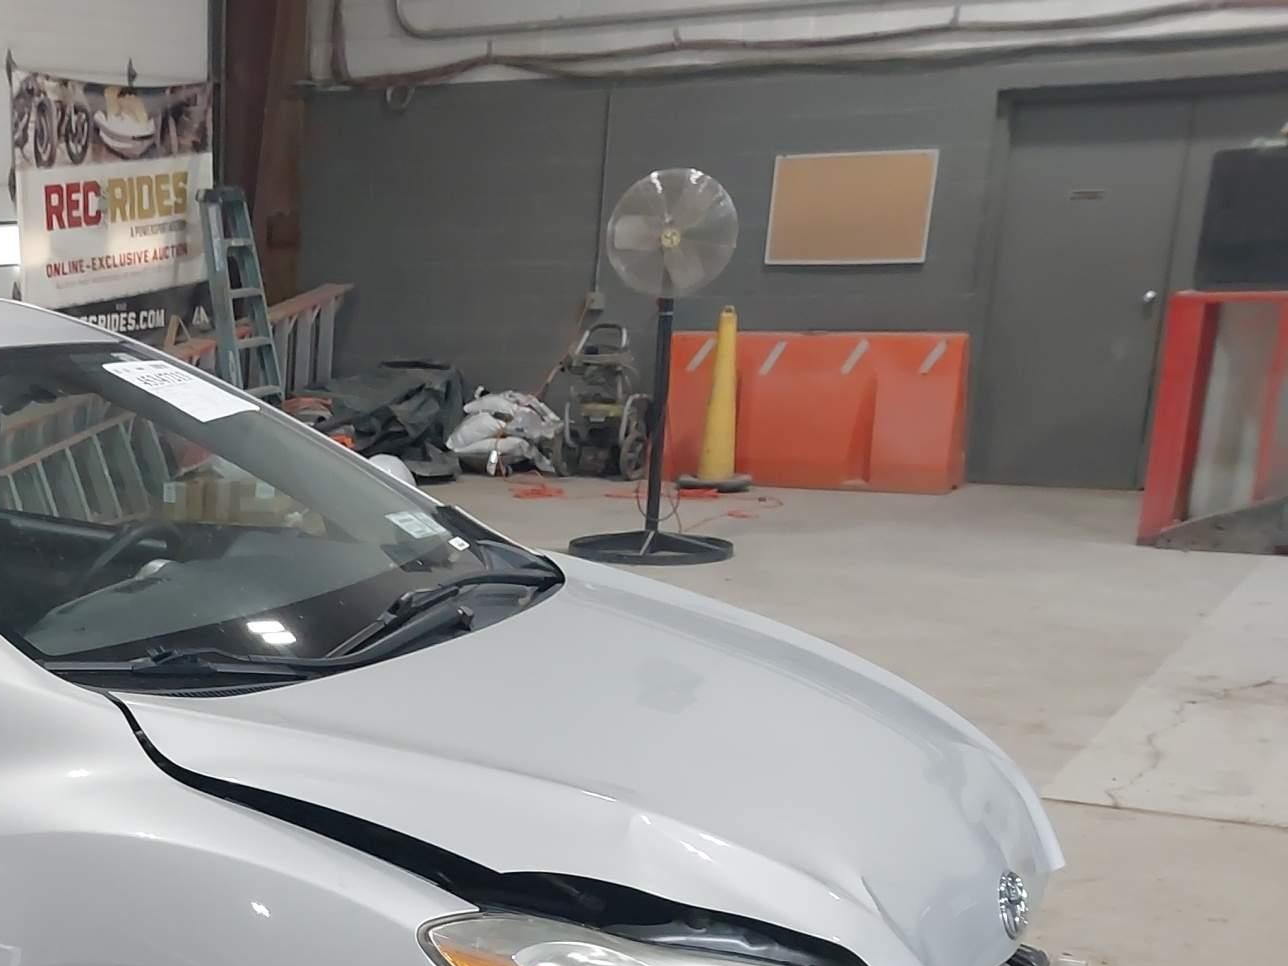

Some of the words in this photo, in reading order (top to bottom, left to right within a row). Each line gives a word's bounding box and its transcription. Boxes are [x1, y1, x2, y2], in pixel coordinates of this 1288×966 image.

[44, 181, 102, 231] REC
[107, 171, 189, 223] RIDES
[46, 250, 149, 278] ONLINE-EXCLUSIVE
